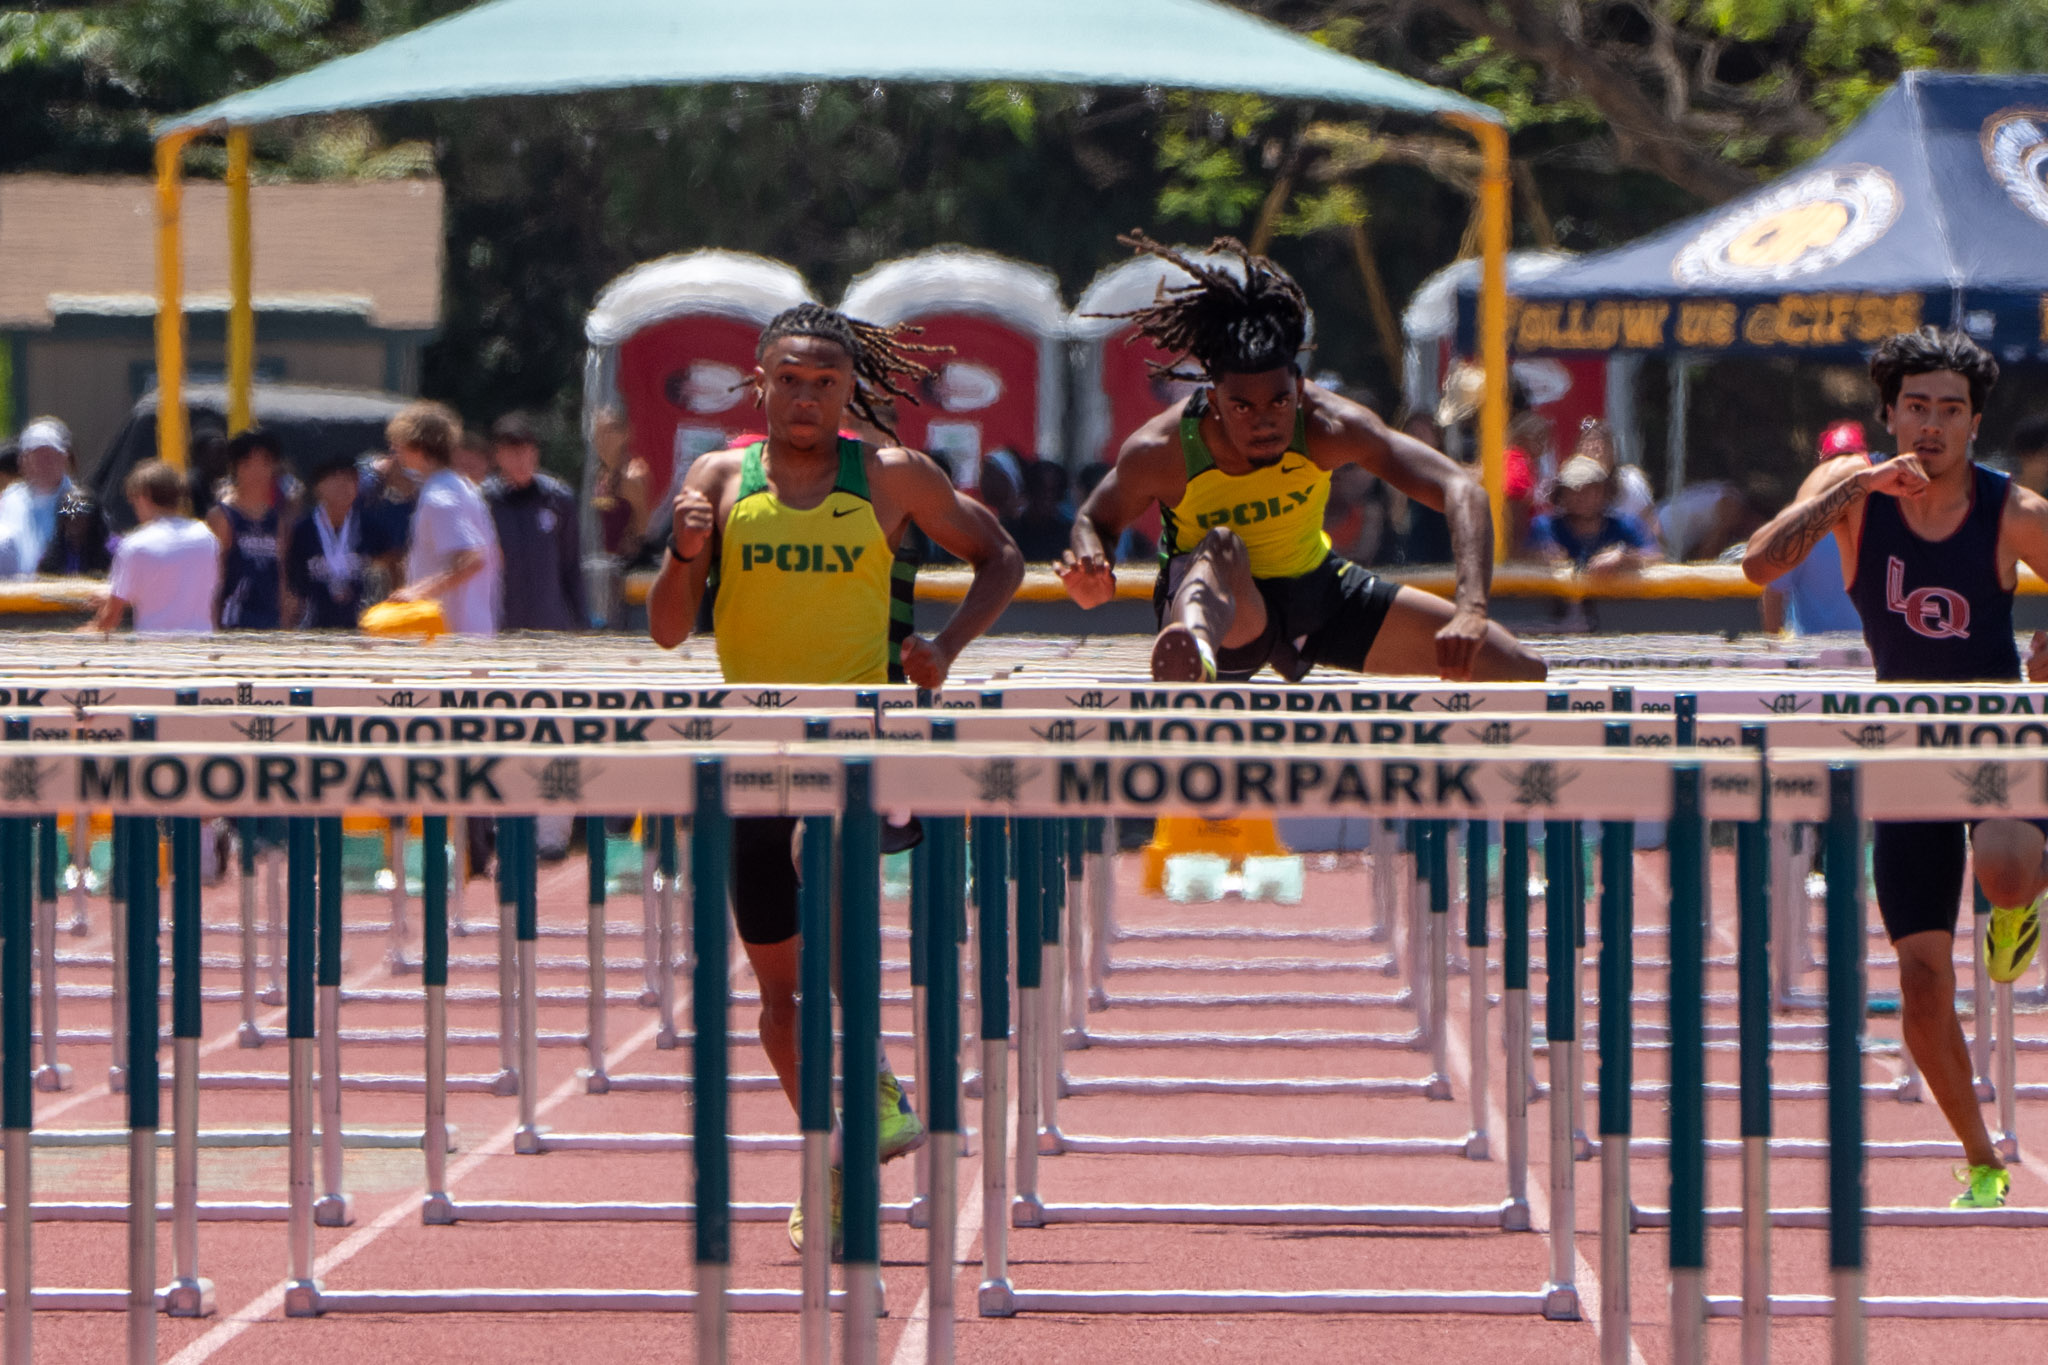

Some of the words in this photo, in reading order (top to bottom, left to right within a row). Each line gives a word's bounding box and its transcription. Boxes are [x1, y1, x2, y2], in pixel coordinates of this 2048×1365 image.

[1196, 484, 1315, 529] POLY
[742, 543, 865, 573] POLY
[1822, 694, 2048, 714] MOORPA
[307, 716, 656, 743] MOORPARK
[79, 756, 504, 804] MOORPARK
[1056, 760, 1485, 807] MOORPARK
